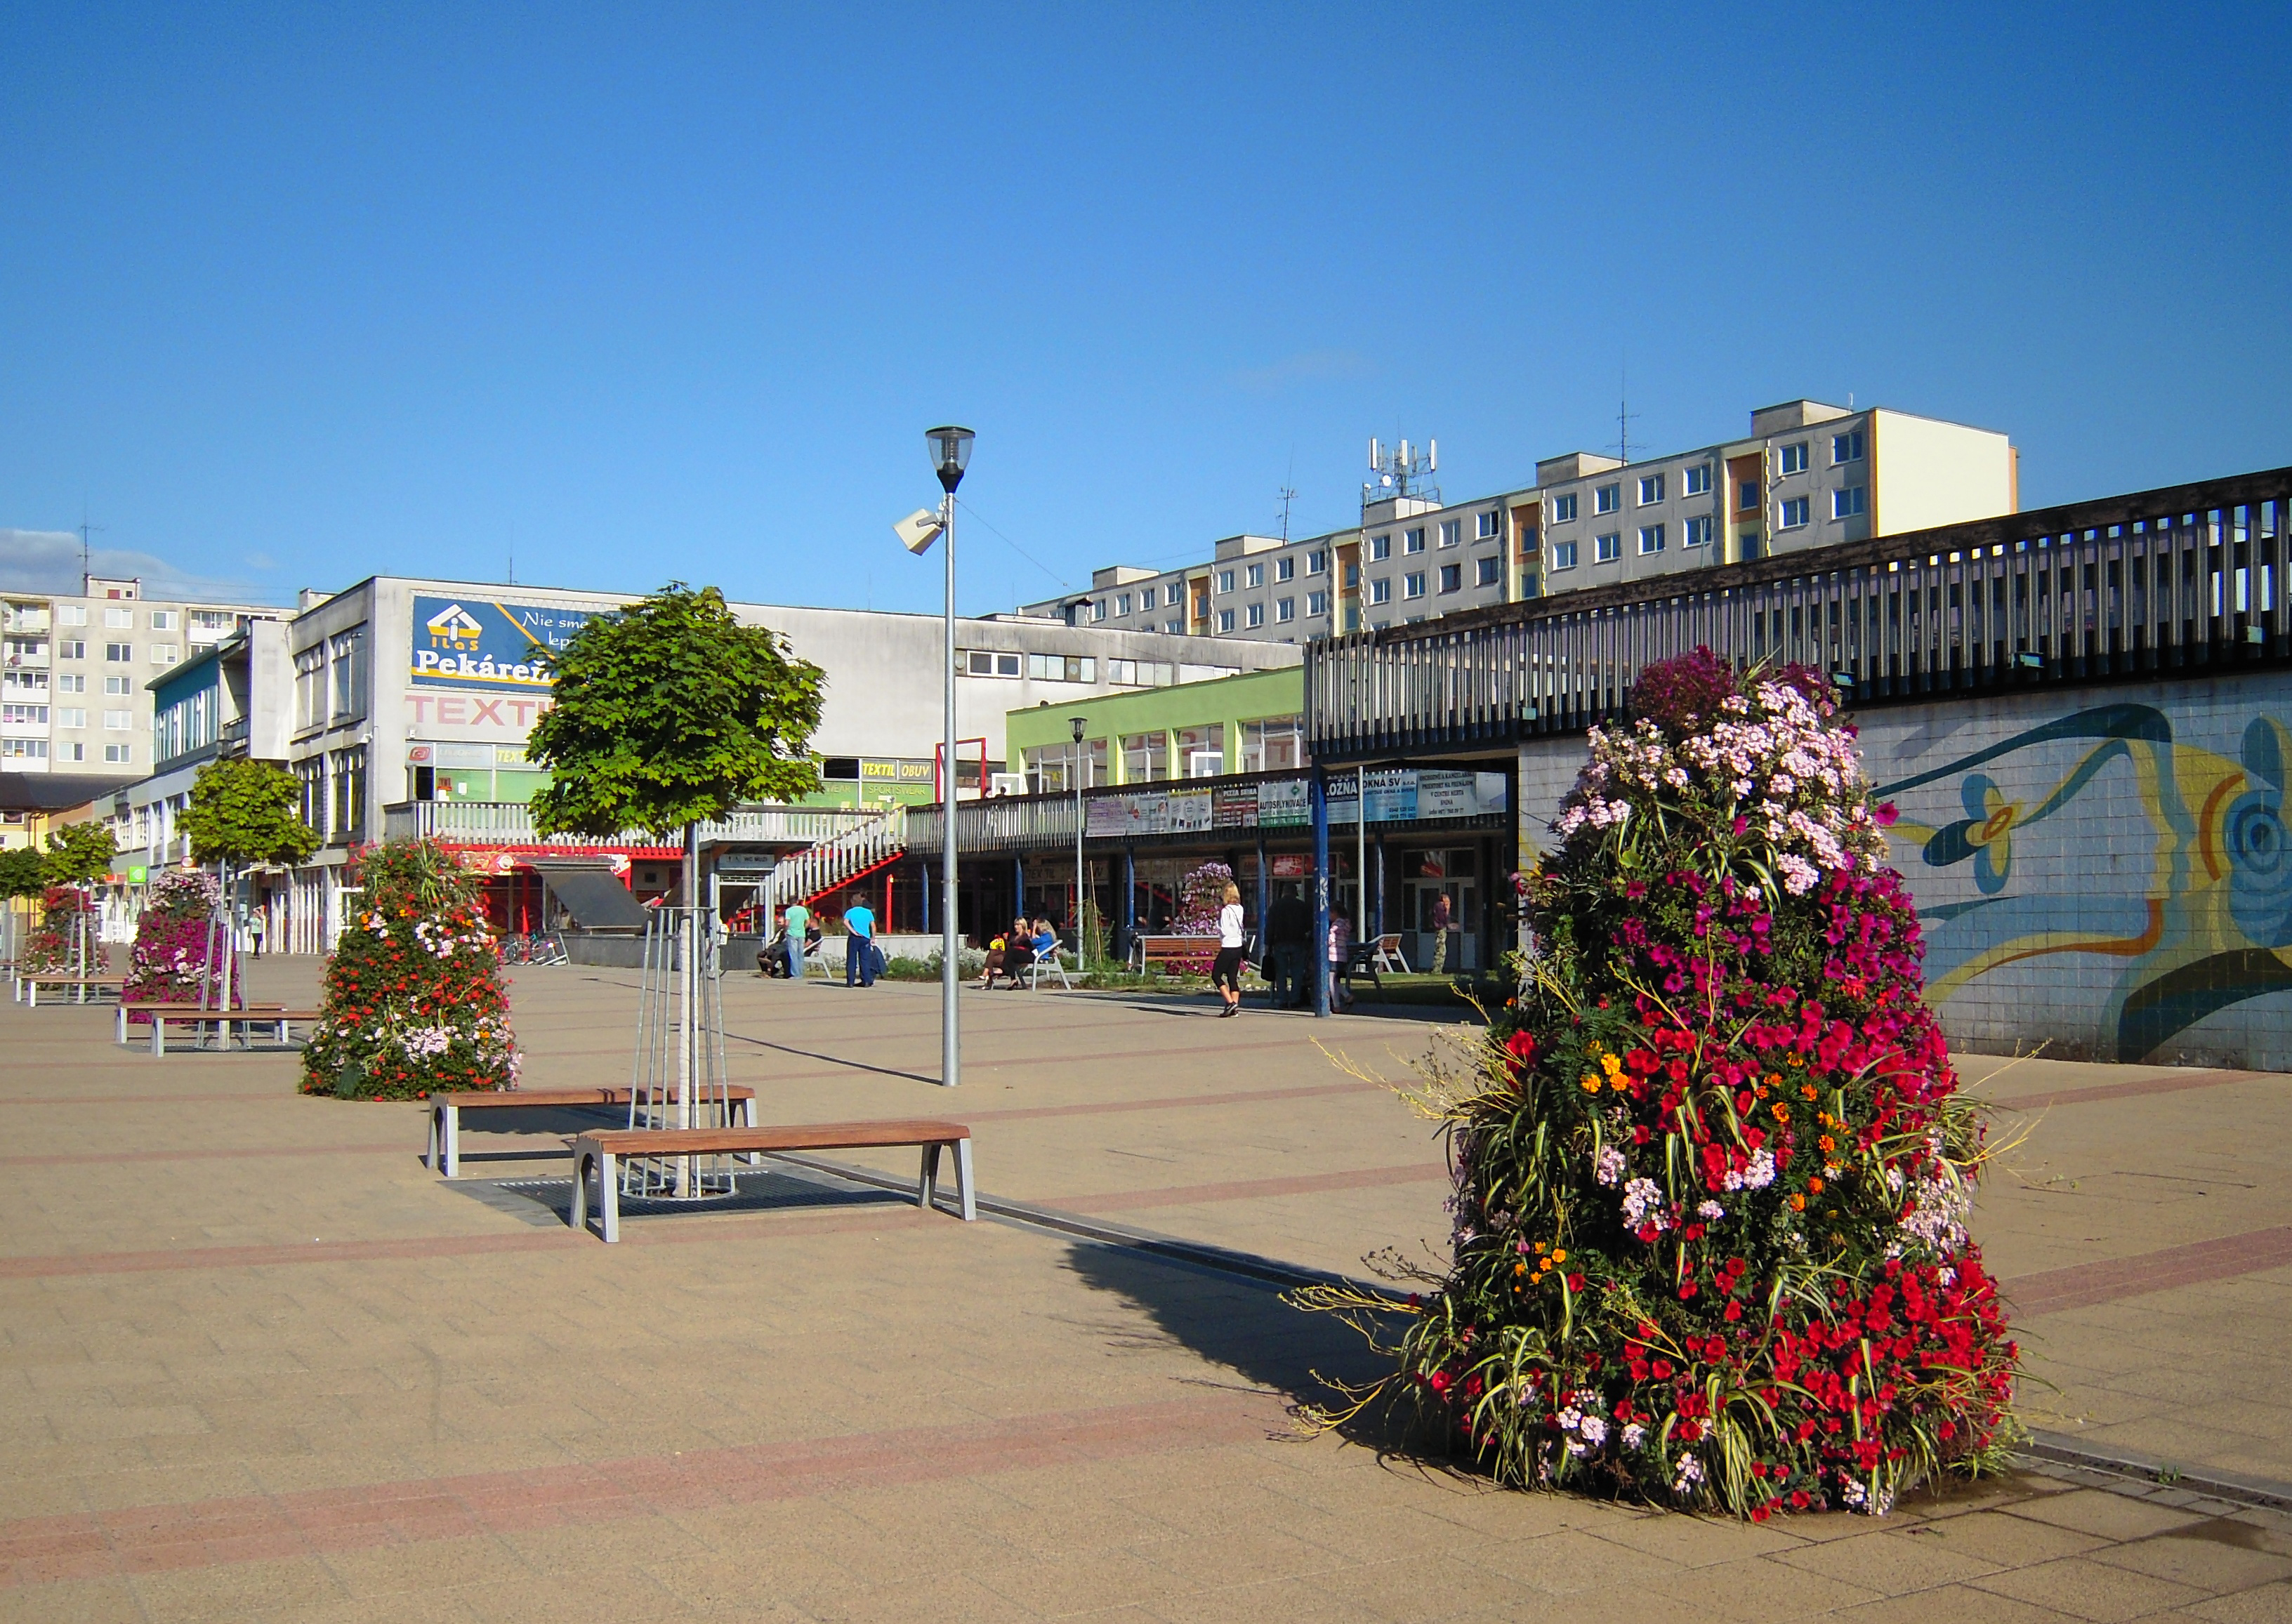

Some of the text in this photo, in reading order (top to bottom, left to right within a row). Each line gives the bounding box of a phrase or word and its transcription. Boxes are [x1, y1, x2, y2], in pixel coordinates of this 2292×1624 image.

[522, 611, 588, 629] Nie sme
[863, 763, 930, 777] TEXTIL OBUV
[1326, 779, 1358, 797] OŽŇA
[1363, 777, 1386, 788] OKNÁ
[1388, 777, 1401, 787] SV
[868, 786, 926, 796] SPORTSWEAR
